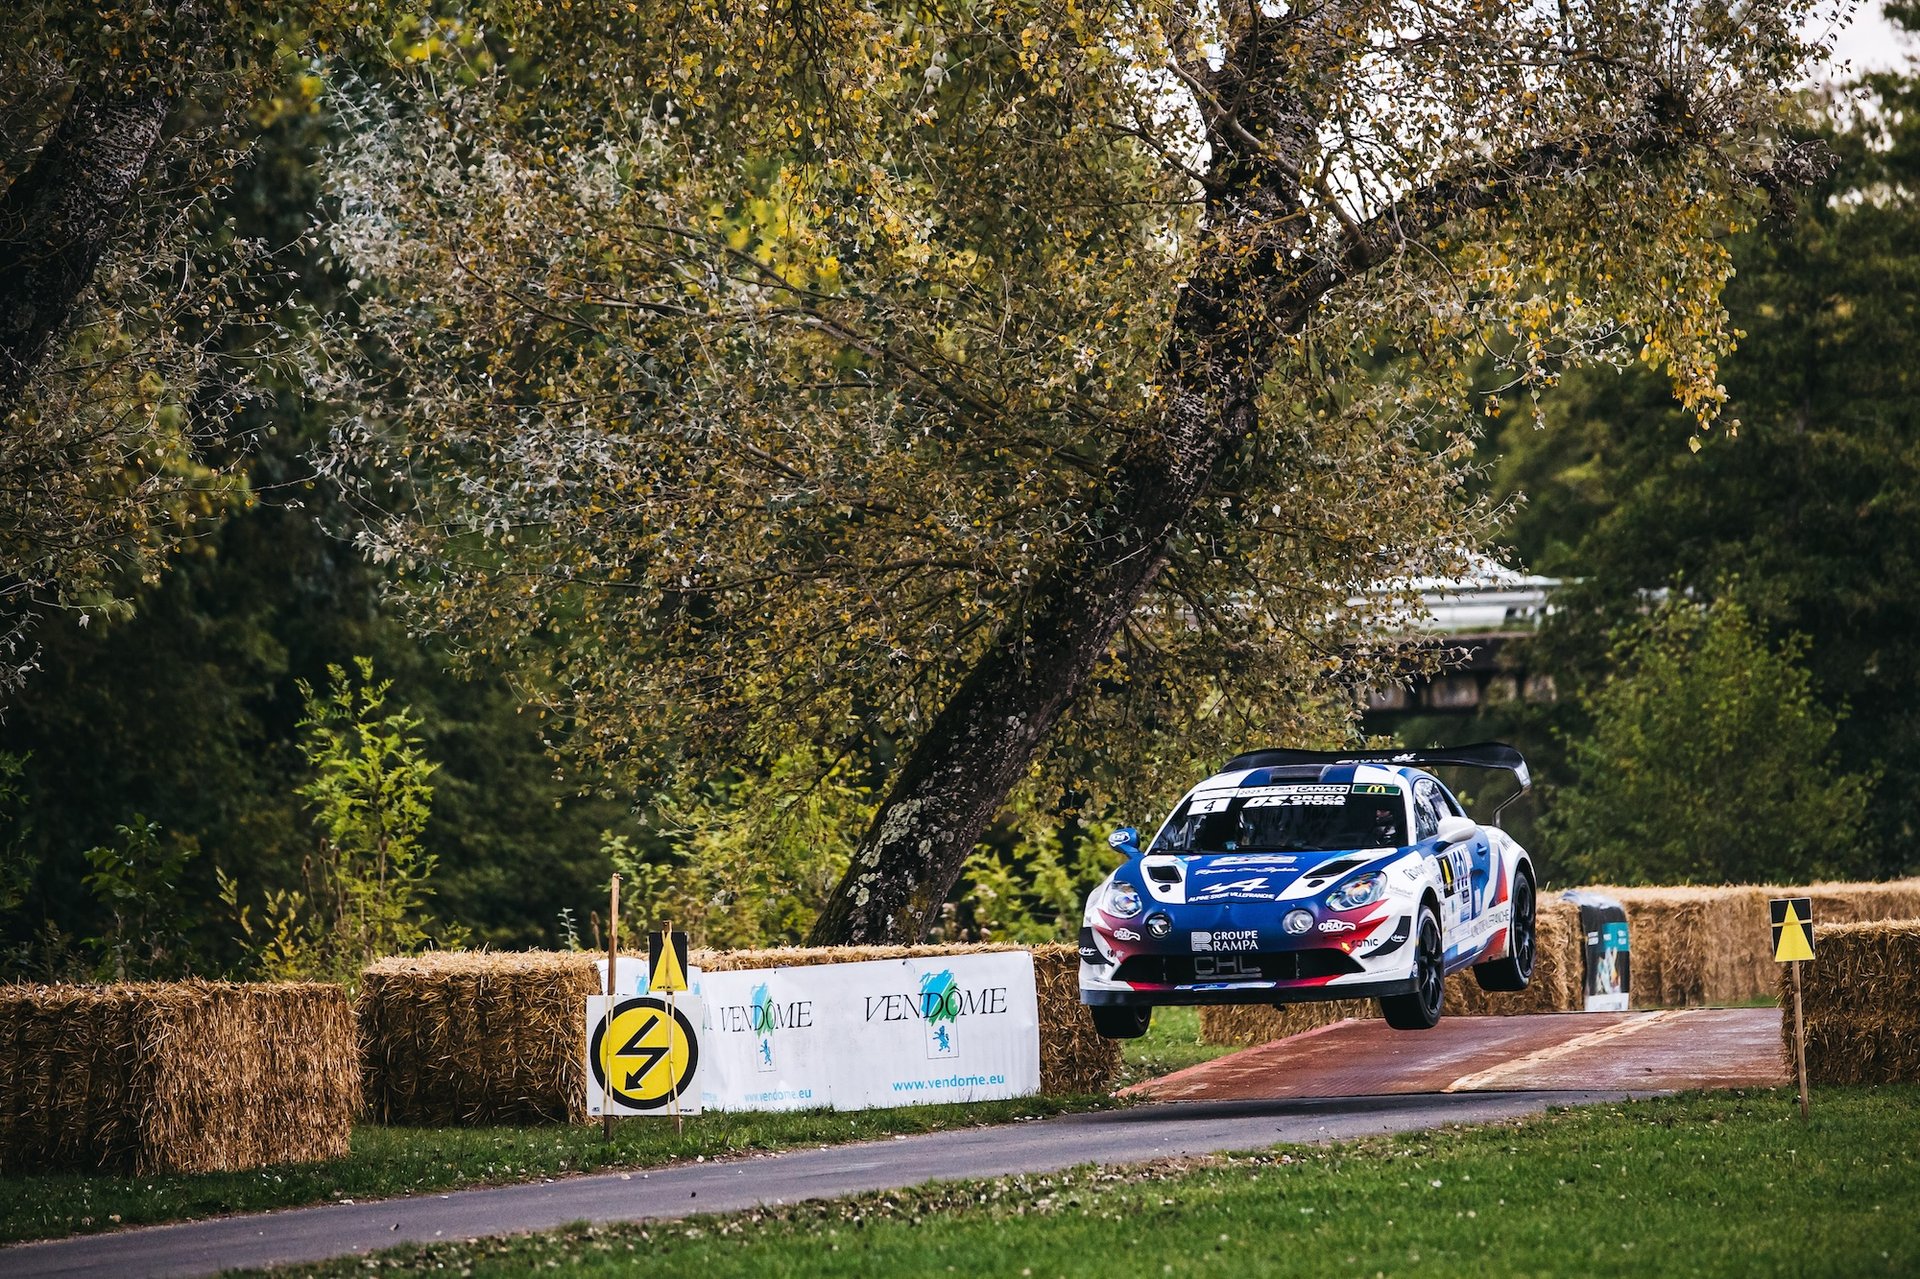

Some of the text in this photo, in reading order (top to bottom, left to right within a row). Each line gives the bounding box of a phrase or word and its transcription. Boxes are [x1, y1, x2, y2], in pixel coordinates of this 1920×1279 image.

[1204, 800, 1216, 812] 4
[1213, 930, 1258, 941] GROUPE
[1213, 939, 1259, 952] RAMPA
[864, 985, 1008, 1022] VENDÔME
[720, 998, 813, 1033] VENDÔME
[892, 1074, 1005, 1091] www.vendome.eu
